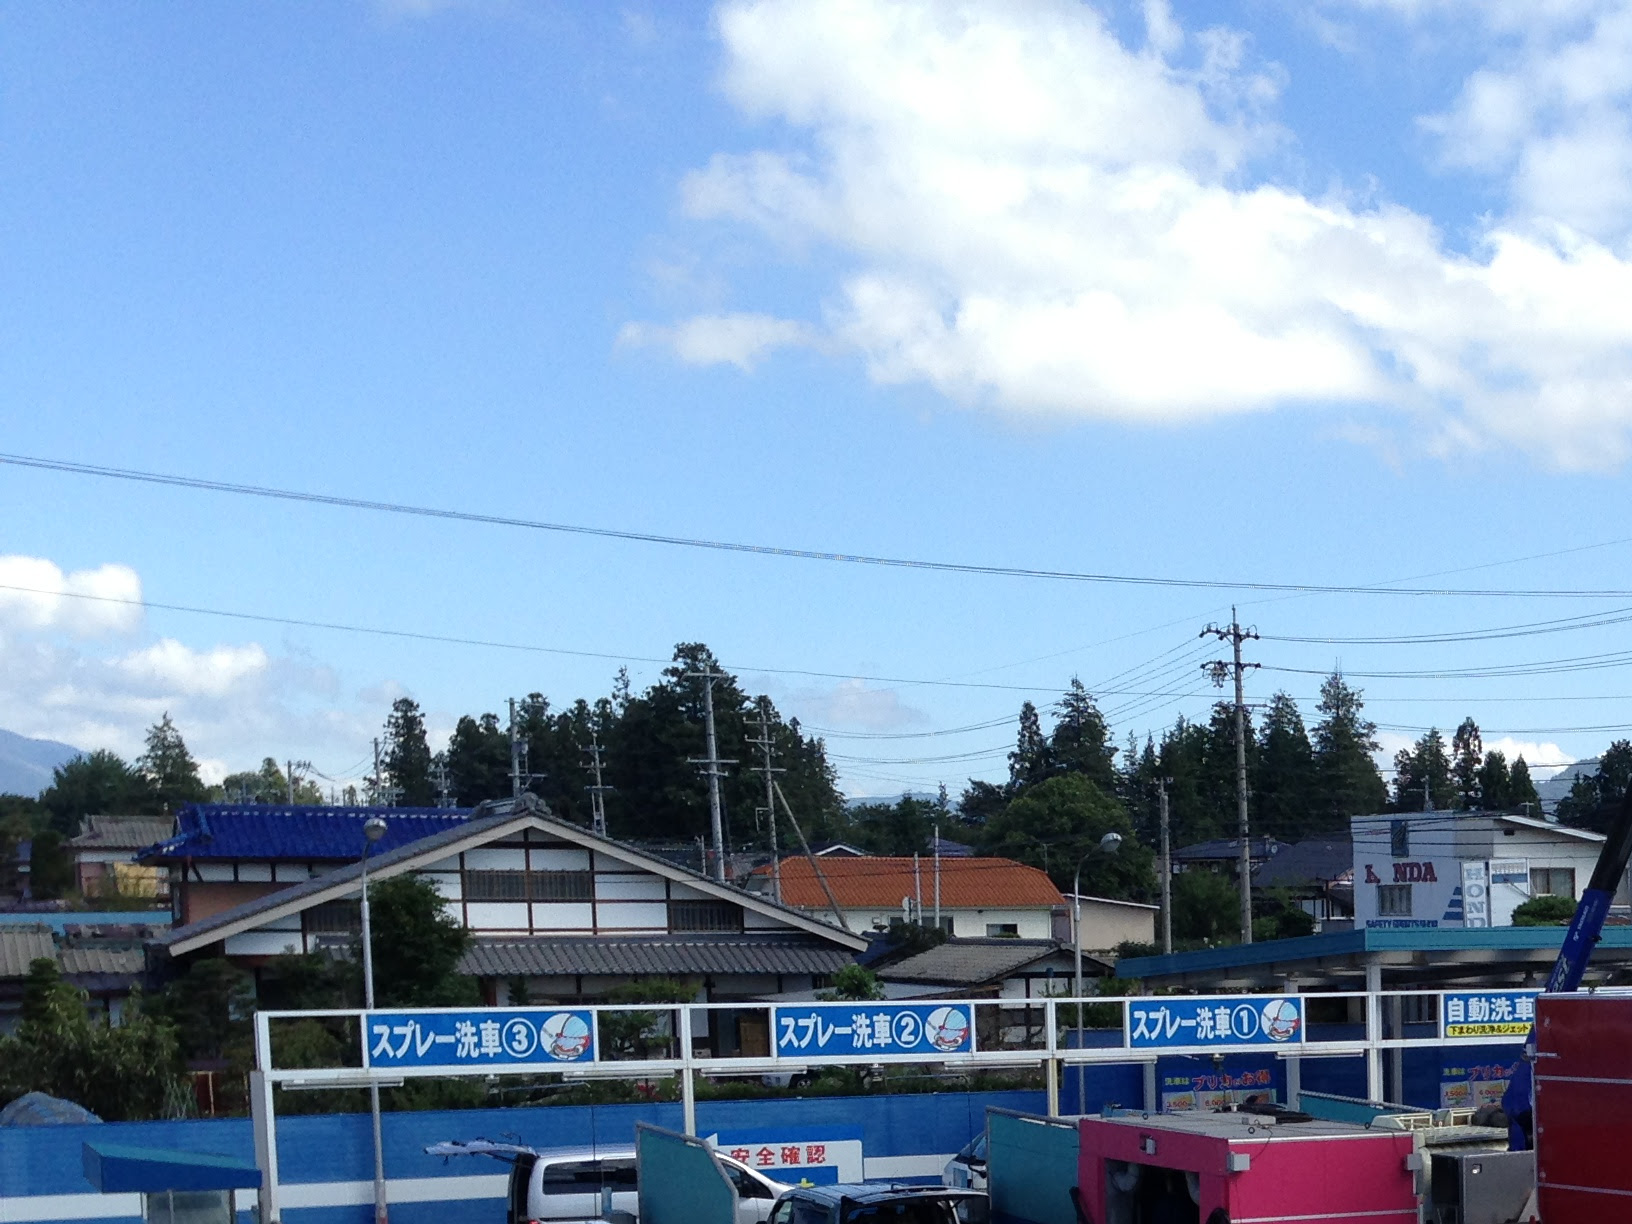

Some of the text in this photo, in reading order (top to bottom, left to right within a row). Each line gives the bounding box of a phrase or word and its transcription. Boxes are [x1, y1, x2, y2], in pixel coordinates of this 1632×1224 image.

[1447, 995, 1534, 1022] 自動洗車
[730, 1144, 826, 1166] 安全確認
